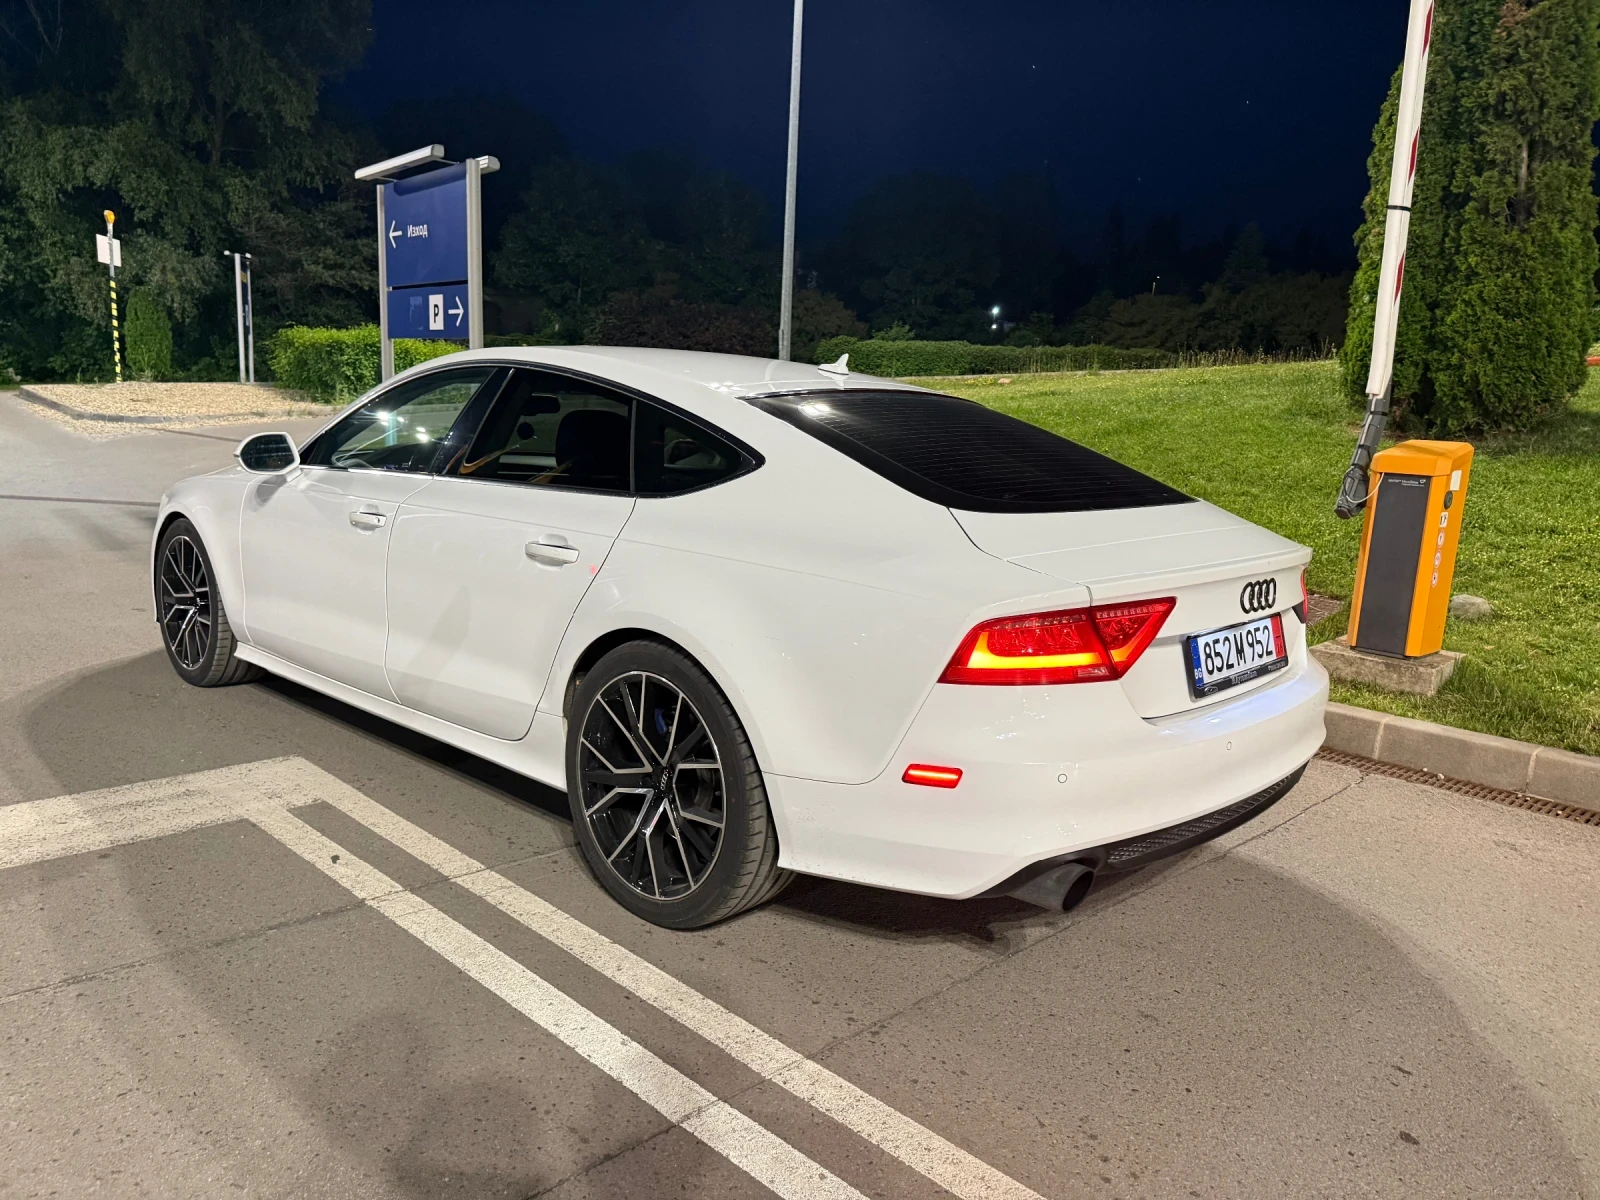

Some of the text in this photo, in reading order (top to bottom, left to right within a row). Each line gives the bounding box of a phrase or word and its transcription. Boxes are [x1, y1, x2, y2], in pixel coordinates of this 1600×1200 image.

[407, 224, 428, 238] Изход
[433, 304, 440, 324] P
[1194, 667, 1203, 680] BG
